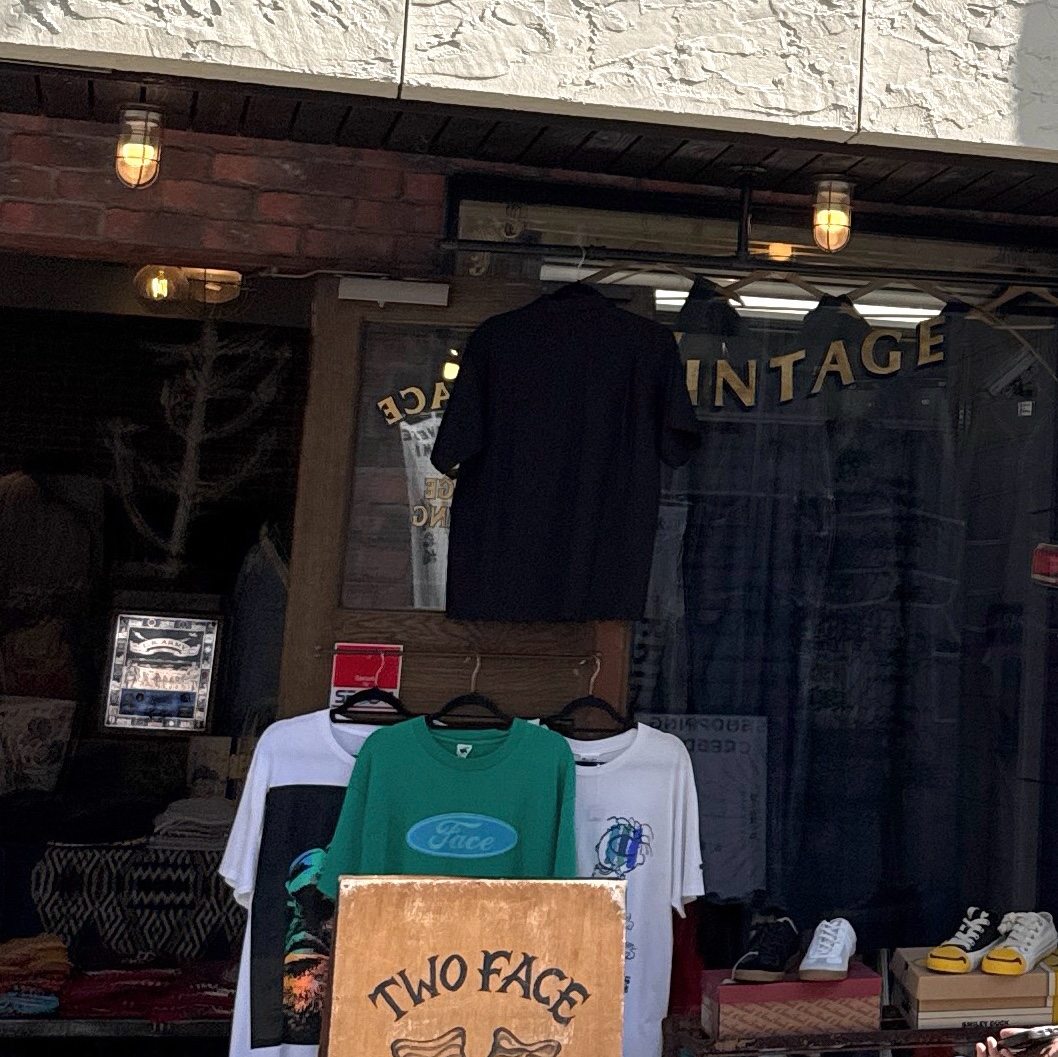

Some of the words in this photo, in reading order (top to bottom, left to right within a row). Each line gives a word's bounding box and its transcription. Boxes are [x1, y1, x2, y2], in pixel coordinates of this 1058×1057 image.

[673, 315, 946, 407] INTAGE
[427, 820, 496, 850] Face
[368, 953, 468, 1022] TWO
[477, 950, 592, 1026] FACE
